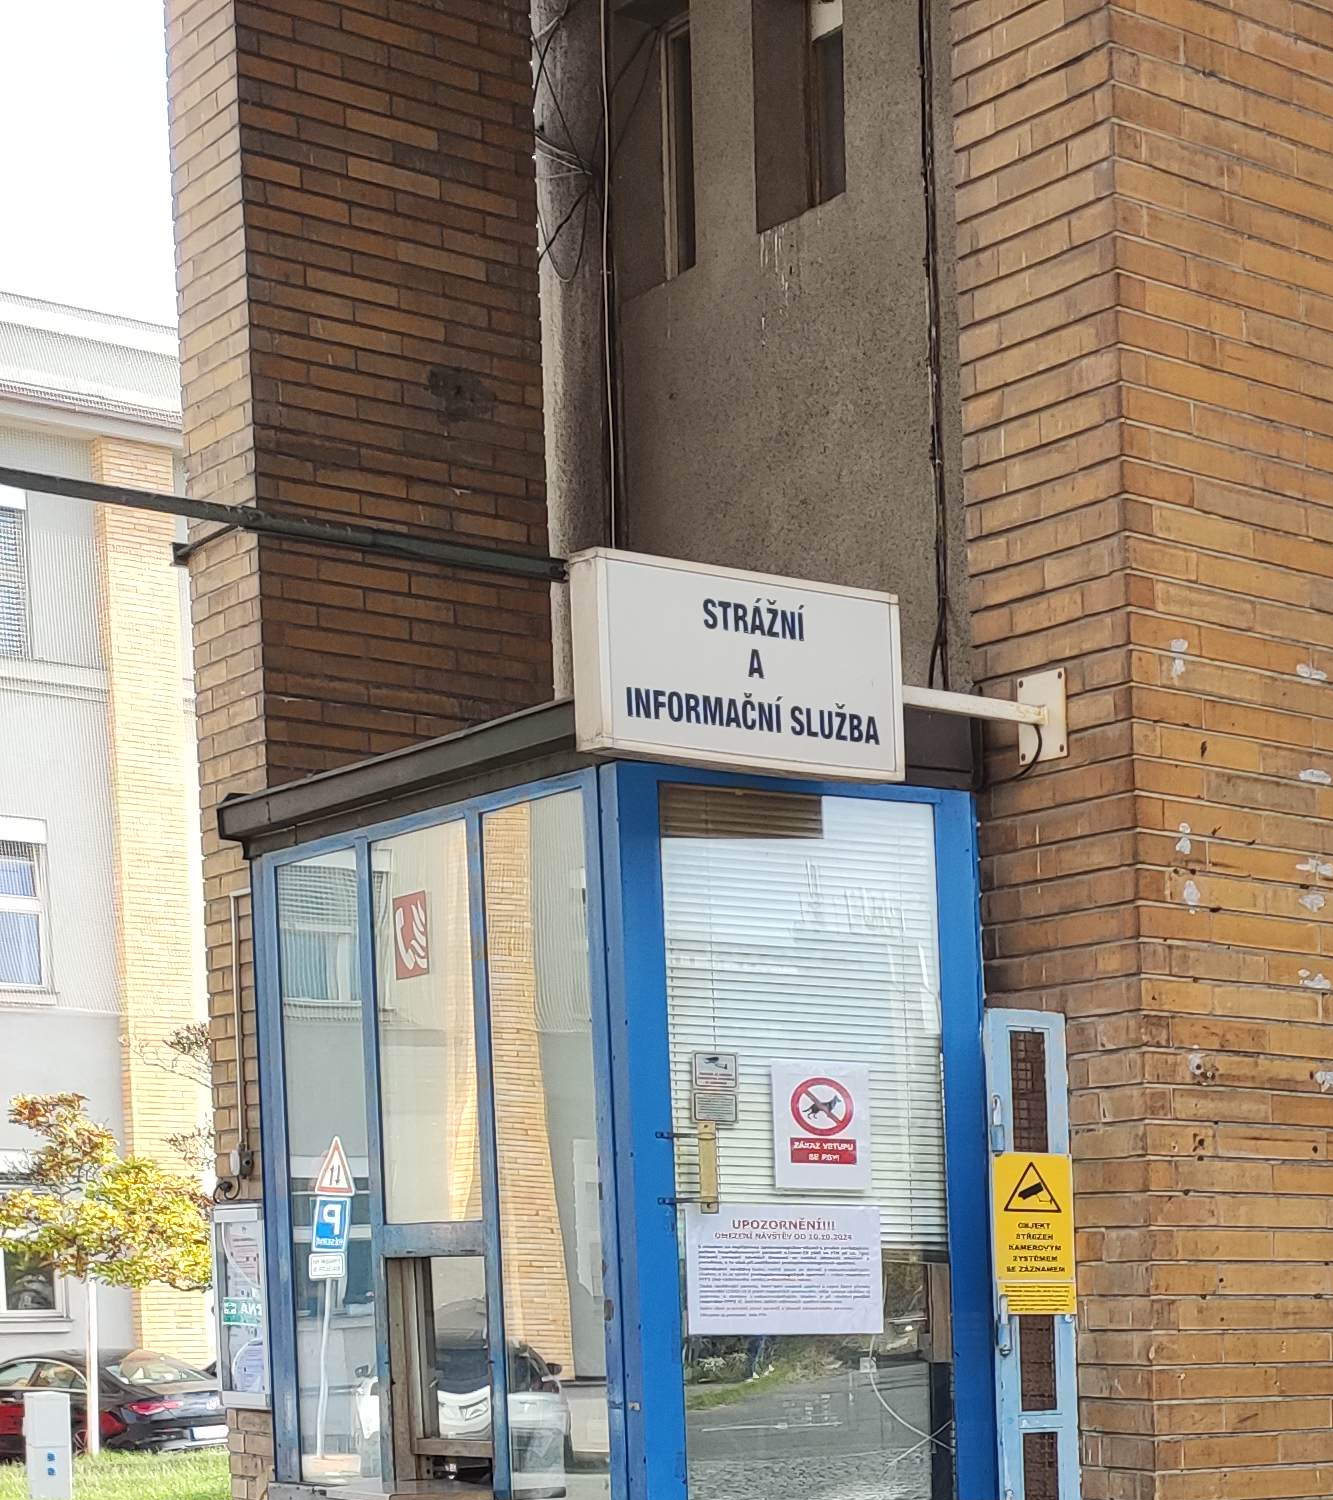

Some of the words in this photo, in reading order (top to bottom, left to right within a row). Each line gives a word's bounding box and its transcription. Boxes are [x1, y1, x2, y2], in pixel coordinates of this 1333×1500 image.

[702, 596, 806, 642] STRÁŽNÍ
[748, 649, 765, 679] A
[625, 686, 783, 734] INFORMAČNÍ
[790, 698, 881, 746] SLUŽBA
[731, 1218, 836, 1231] UPOZORNĚNÍ!!!
